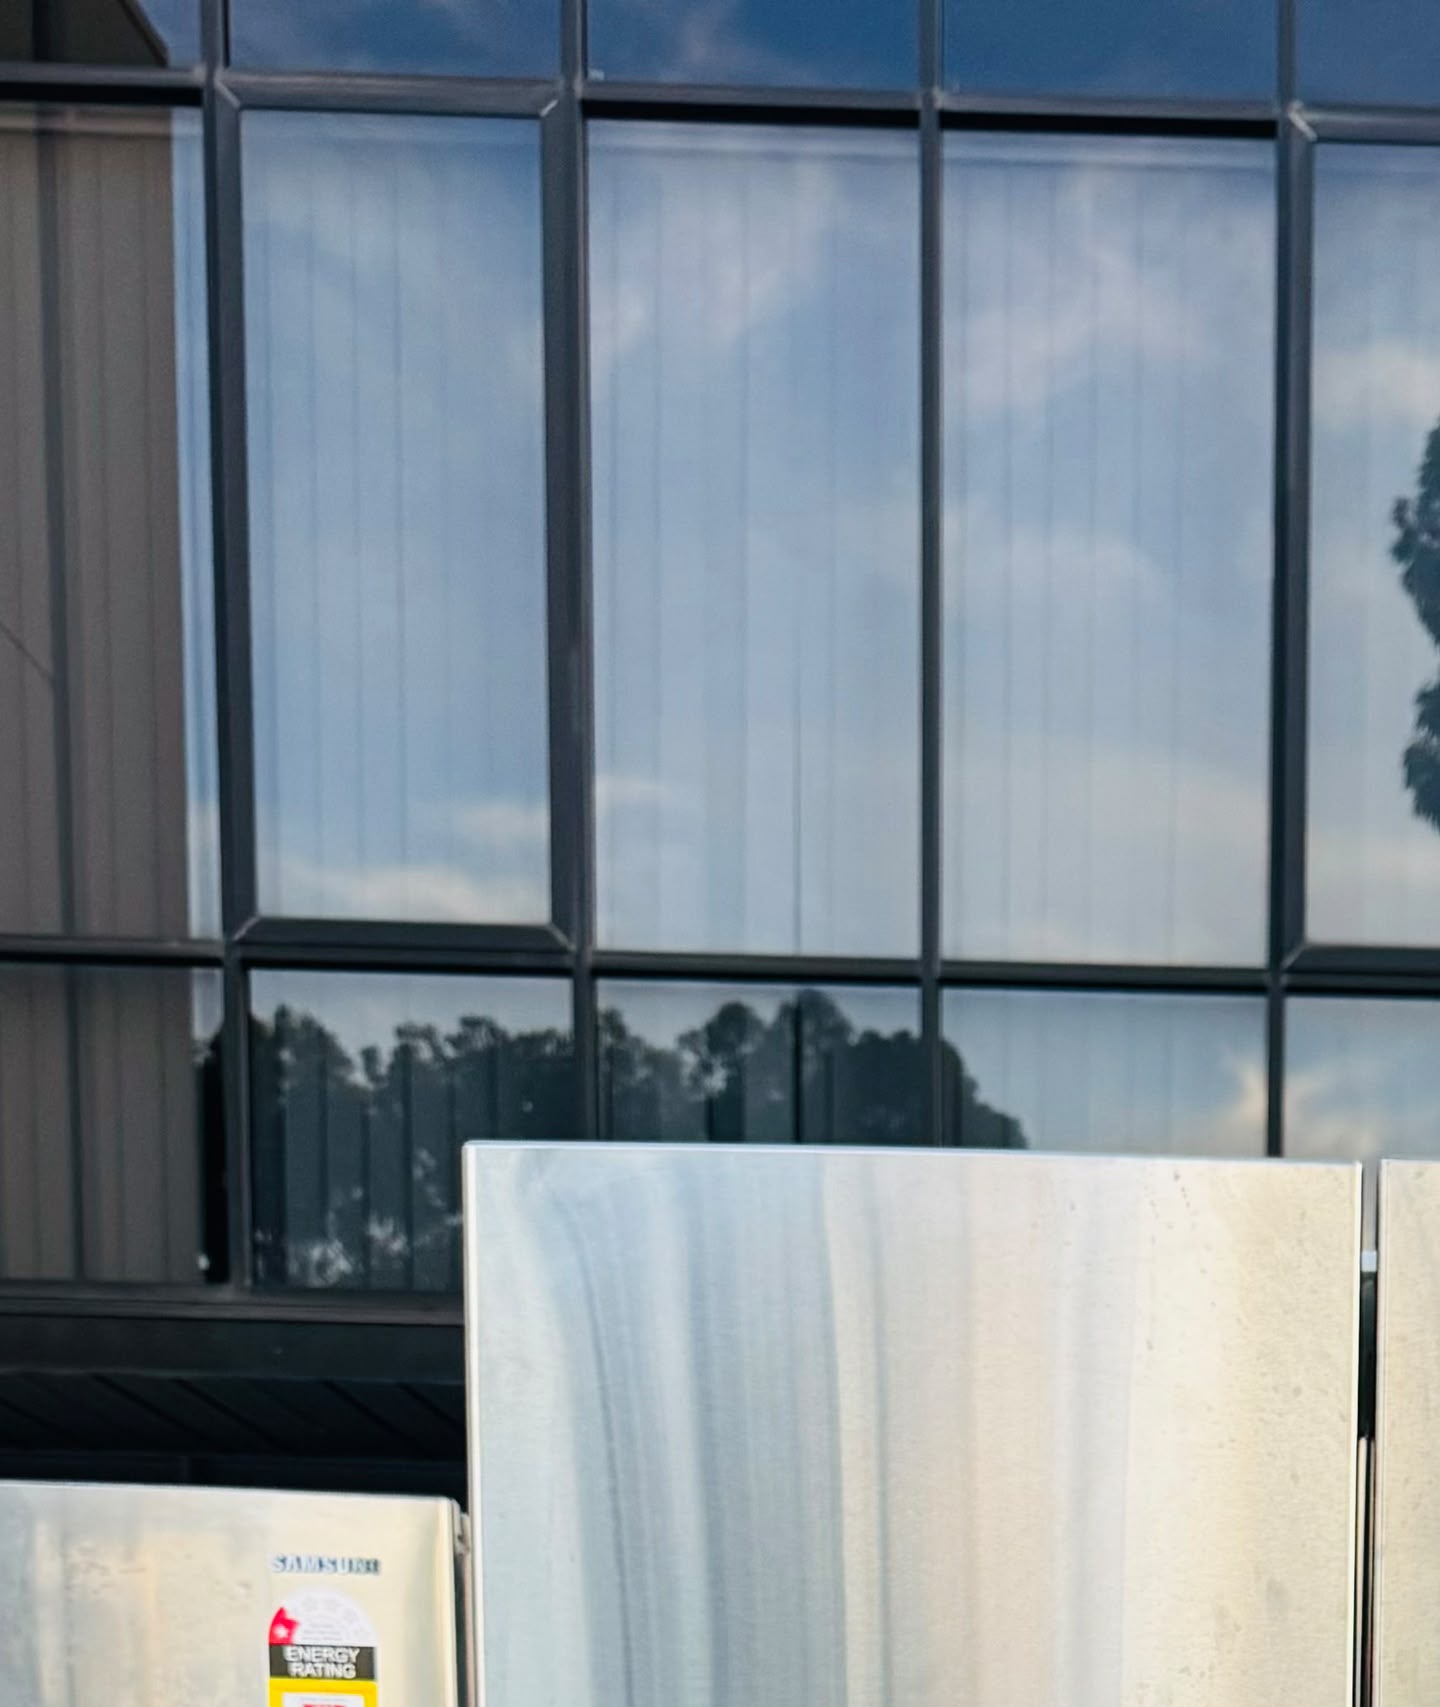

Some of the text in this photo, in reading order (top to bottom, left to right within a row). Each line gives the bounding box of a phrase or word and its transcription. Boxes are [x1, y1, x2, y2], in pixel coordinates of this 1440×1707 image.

[272, 1556, 380, 1575] SAMSUNG
[284, 1646, 360, 1662] ENERGY
[288, 1662, 357, 1679] RATING
